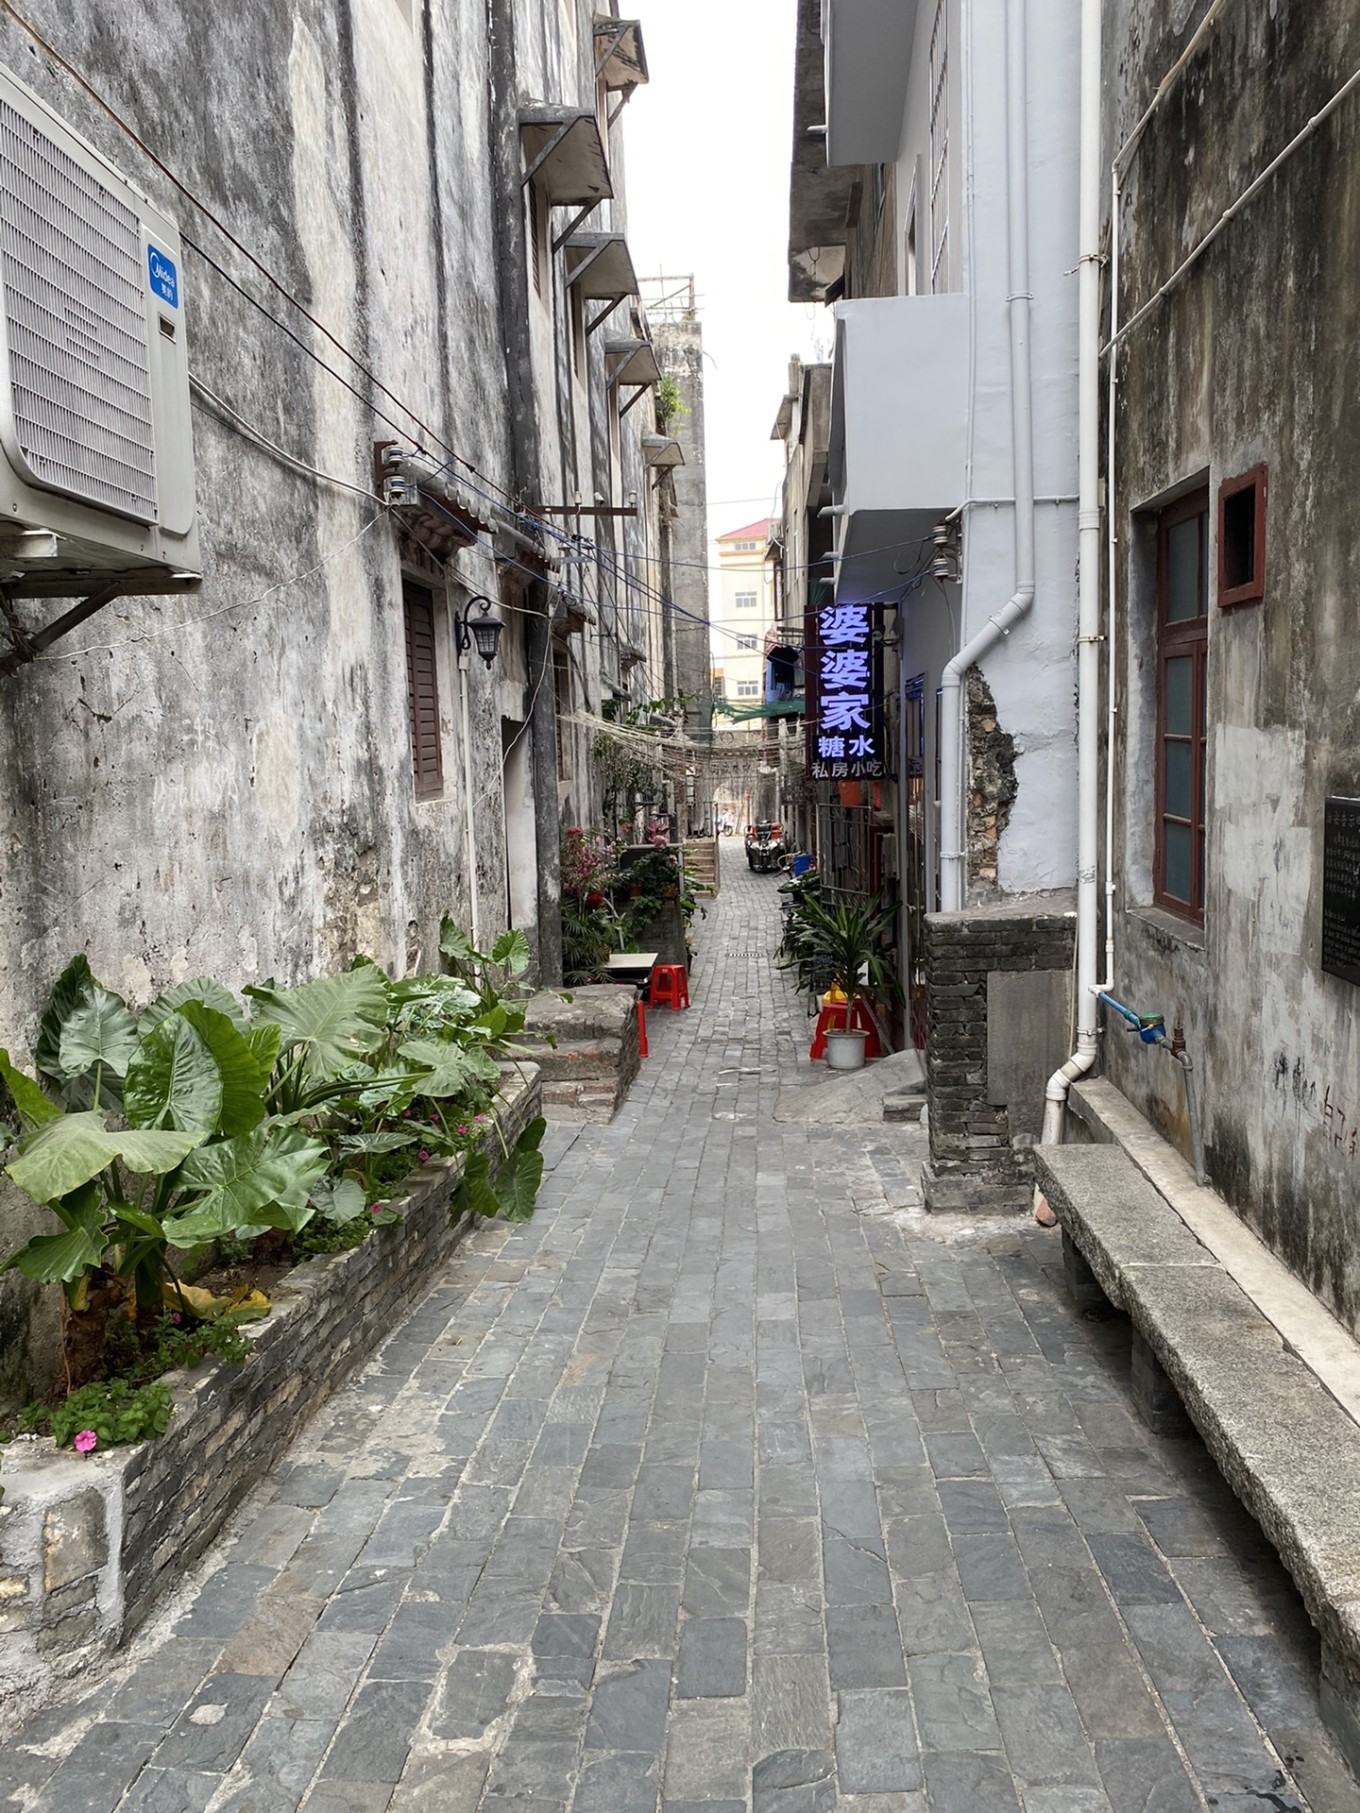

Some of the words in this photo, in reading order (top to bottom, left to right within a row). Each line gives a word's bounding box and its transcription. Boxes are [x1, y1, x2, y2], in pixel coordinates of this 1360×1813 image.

[151, 254, 175, 288] Midea
[820, 606, 870, 730] 婆婆家
[818, 736, 875, 758] 糖水
[812, 760, 883, 779] 私房小吃
